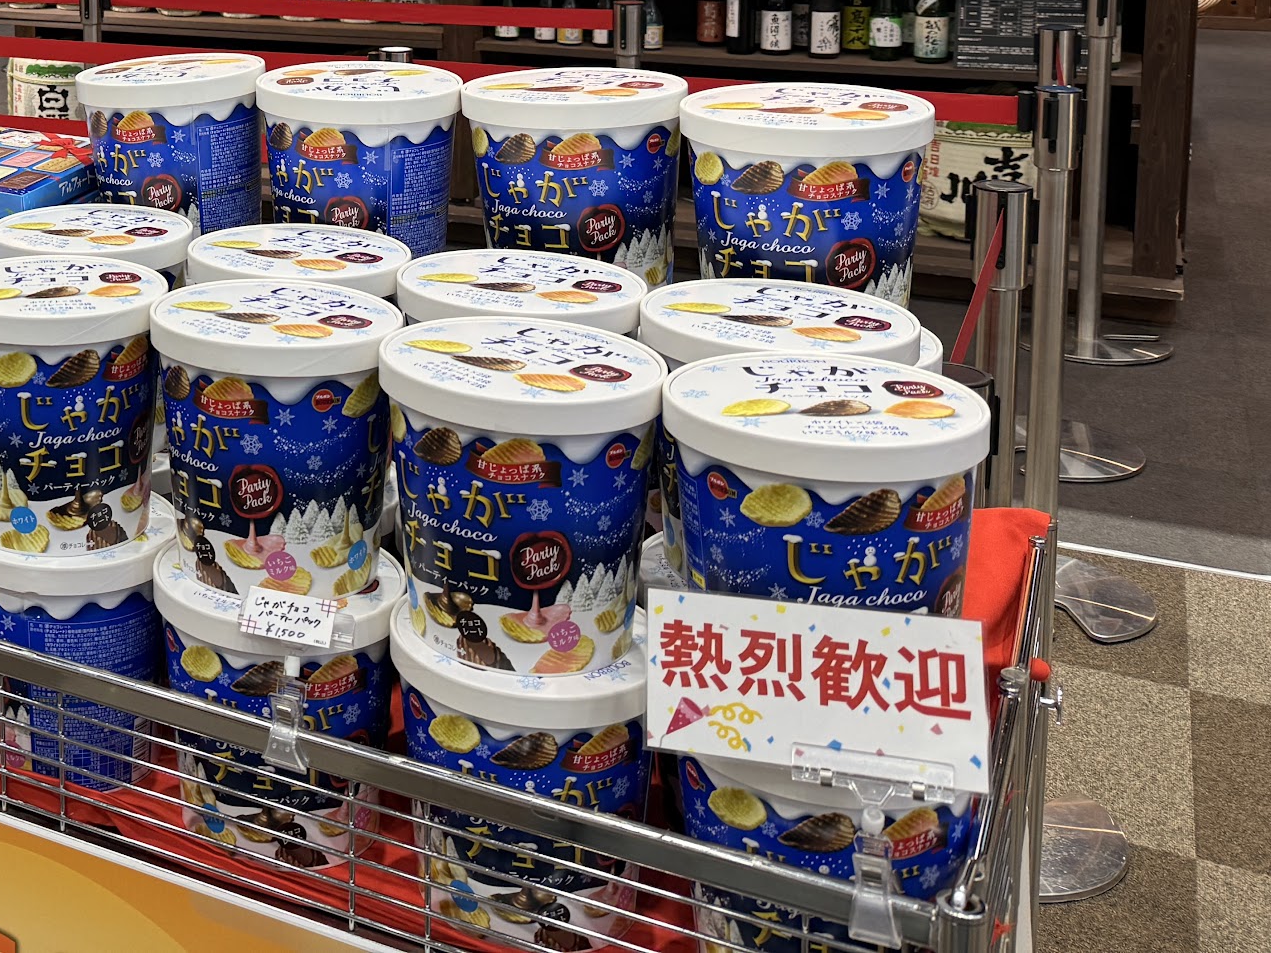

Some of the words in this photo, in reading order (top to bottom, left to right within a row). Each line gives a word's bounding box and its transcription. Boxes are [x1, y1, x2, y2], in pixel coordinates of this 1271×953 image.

[482, 162, 588, 208] じゃが
[491, 199, 521, 217] Jaga
[522, 205, 567, 219] choco
[711, 190, 842, 242] じゃが
[489, 214, 571, 249] チョコ
[585, 215, 616, 234] Party
[590, 229, 616, 244] Pack
[201, 395, 252, 410] 甘じょっぱ系
[208, 406, 256, 417] チョコスナック
[29, 430, 75, 450] Jaga
[77, 425, 123, 443] choco
[19, 440, 125, 483] チョコ
[477, 458, 543, 475] 甘じょっぱ系
[44, 475, 116, 491] パーティーパック
[236, 477, 272, 496] Party
[243, 494, 273, 510] Pack
[11, 514, 35, 526] ホワイト
[92, 516, 111, 531] レート
[267, 556, 292, 567] いちご
[269, 565, 296, 576] ミルク味
[418, 562, 490, 596] パーティーパック
[254, 596, 311, 614] じゃがチョコ
[258, 610, 322, 628] パーティーパック
[584, 659, 632, 681] BOURBON
[660, 619, 972, 721] 熱烈歓迎
